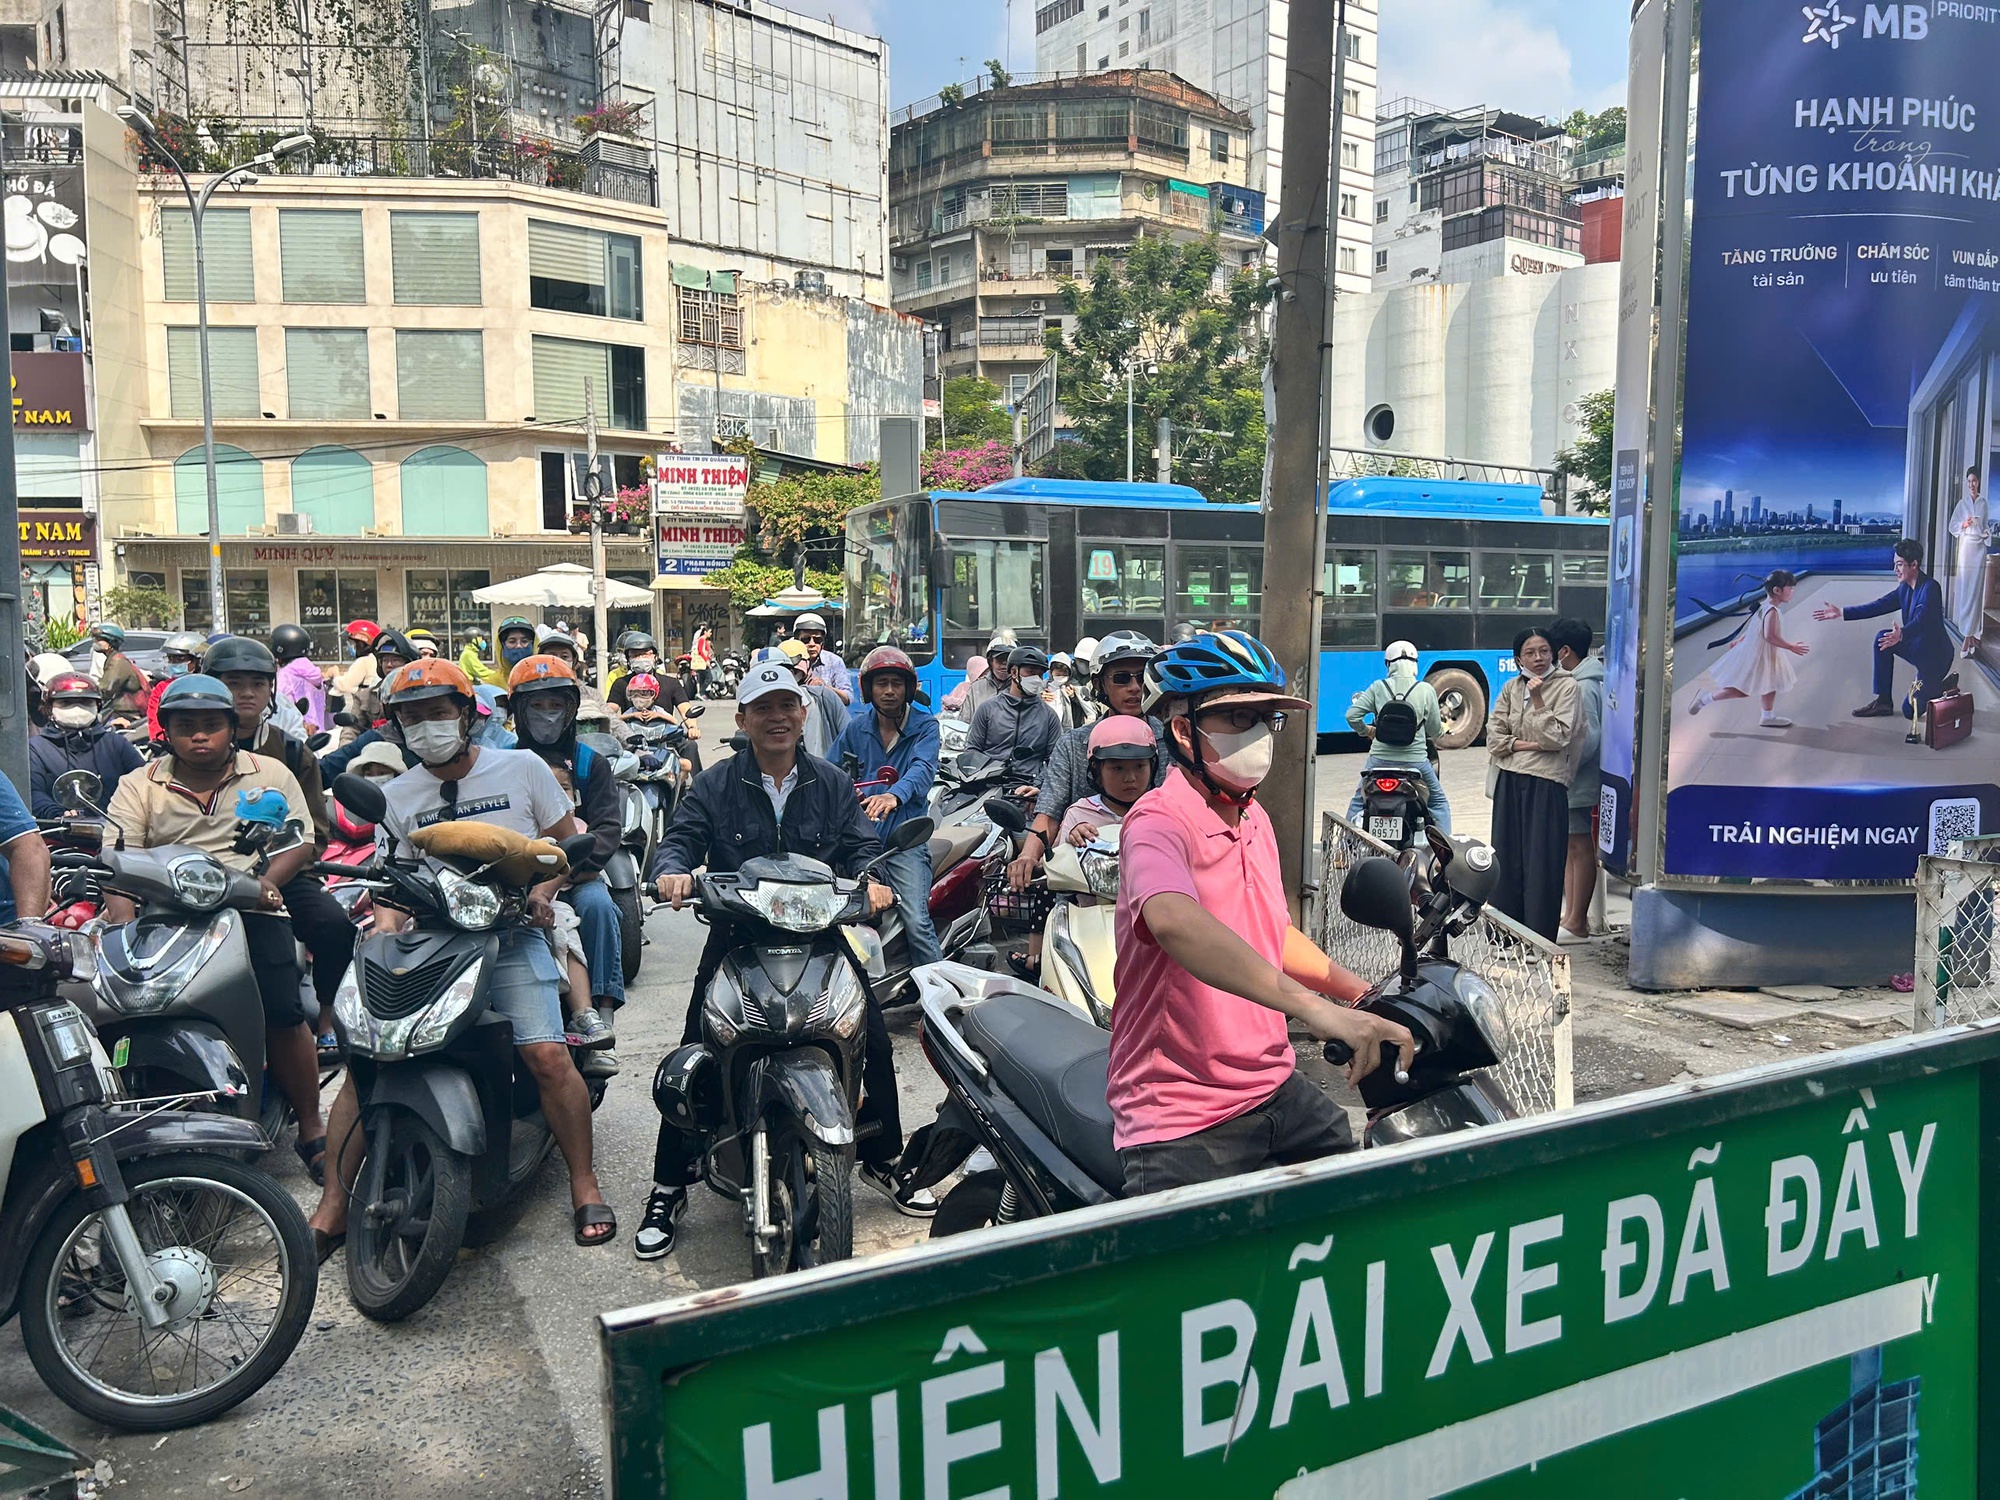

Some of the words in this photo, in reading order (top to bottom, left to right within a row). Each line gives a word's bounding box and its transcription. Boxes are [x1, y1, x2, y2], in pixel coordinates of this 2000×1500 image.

[1863, 4, 1928, 40] MB
[1795, 97, 1894, 134] HẠNH
[1902, 95, 1976, 132] PHÚC
[1720, 162, 1818, 198] TỪNG
[1827, 154, 1956, 195] KHOẢNH
[1722, 248, 1766, 266] TĂNG
[1770, 243, 1838, 263] TRƯỞNG
[1857, 244, 1901, 259] CHĂM
[1903, 243, 1930, 260] SÓC
[1952, 250, 1975, 266] VUN
[1976, 249, 1999, 269] ĐẮP
[1752, 273, 1773, 288] tài
[1776, 270, 1804, 286] sản
[1870, 271, 1888, 283] ưu
[1891, 268, 1917, 284] tiên
[1944, 273, 1965, 288] tâm
[1967, 273, 1990, 291] thân
[1992, 277, 2000, 293] tr
[24, 409, 72, 424] NAM
[658, 467, 697, 484] MINH
[701, 465, 747, 489] THIỆN
[36, 522, 82, 541] NAM
[661, 527, 700, 542] MINH
[254, 547, 297, 560] MINH
[302, 545, 335, 562] QUÝ
[665, 559, 678, 572] 2
[1093, 555, 1113, 577] 19
[305, 606, 333, 616] 2026
[474, 797, 506, 811] STYLE
[1374, 818, 1398, 828] 59-Y3
[1709, 821, 1761, 844] TRẢI
[1768, 823, 1859, 850] NGHIỆM
[1865, 826, 1919, 844] NGAY
[1181, 1234, 1386, 1457] BÃI
[1425, 1213, 1563, 1379] XE
[1601, 1141, 1730, 1325] ĐÃ
[1764, 1087, 1938, 1277] ĐẦY
